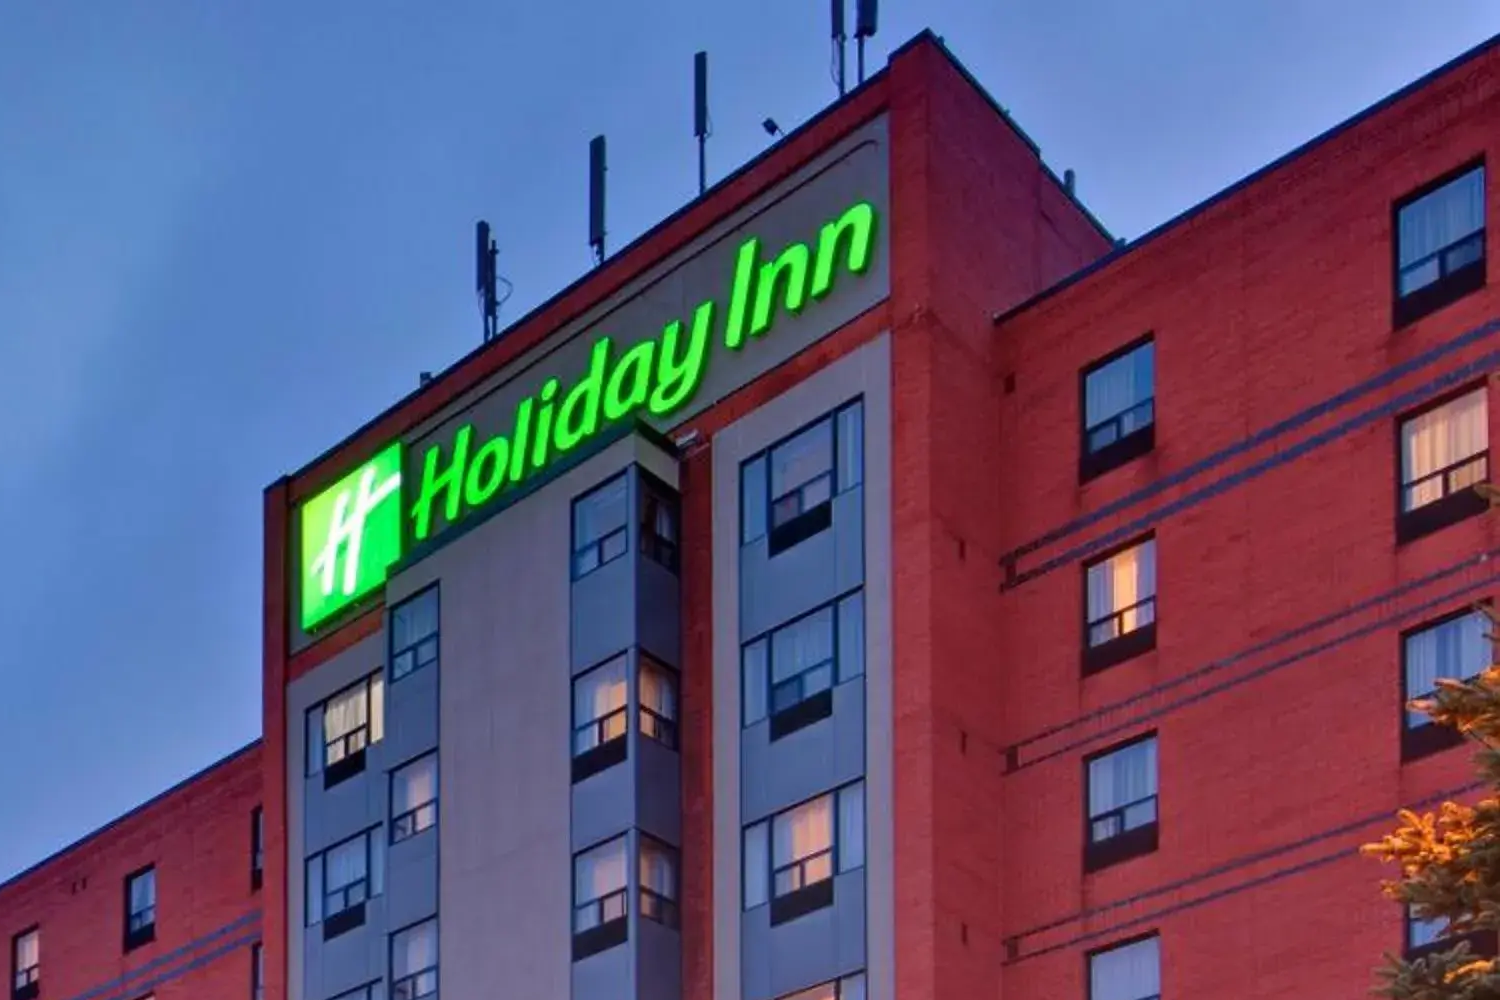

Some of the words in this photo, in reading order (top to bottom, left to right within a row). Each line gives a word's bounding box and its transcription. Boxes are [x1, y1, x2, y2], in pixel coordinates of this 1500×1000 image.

[309, 464, 402, 596] H
[411, 300, 714, 541] Holiday
[724, 201, 875, 349] Inn
